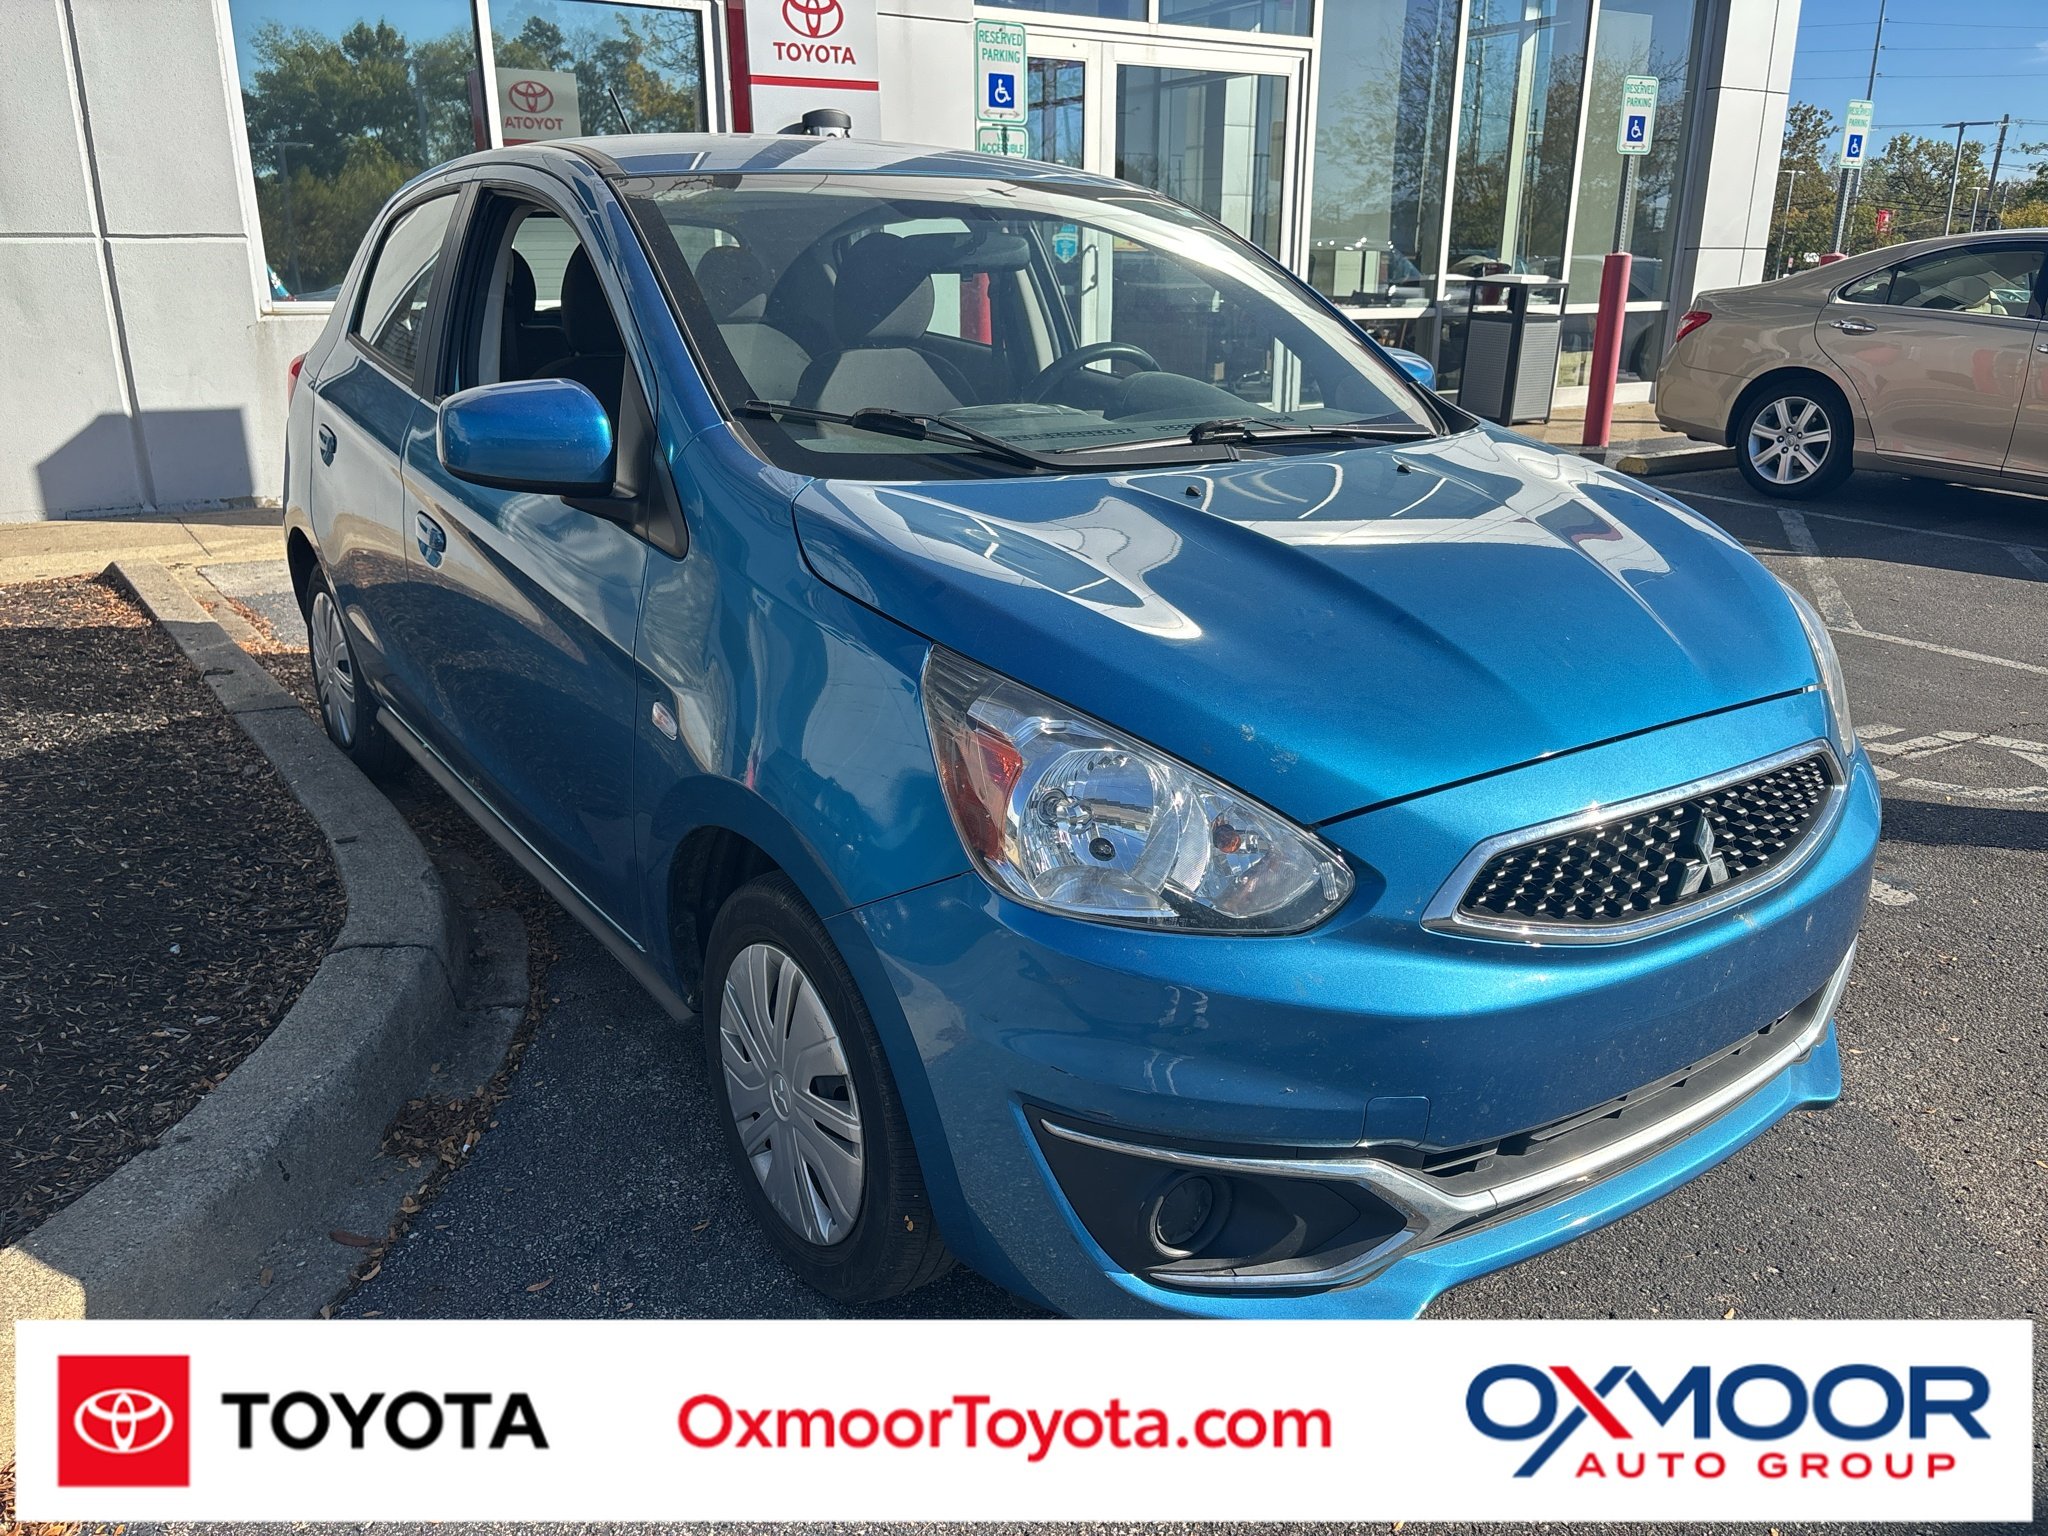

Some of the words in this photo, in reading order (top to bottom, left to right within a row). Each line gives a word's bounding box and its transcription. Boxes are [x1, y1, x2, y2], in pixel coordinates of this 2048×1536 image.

[979, 29, 1023, 47] RESERVED
[772, 41, 856, 65] TOYOTA
[981, 47, 1021, 64] PARKING
[1626, 96, 1652, 108] PARKING
